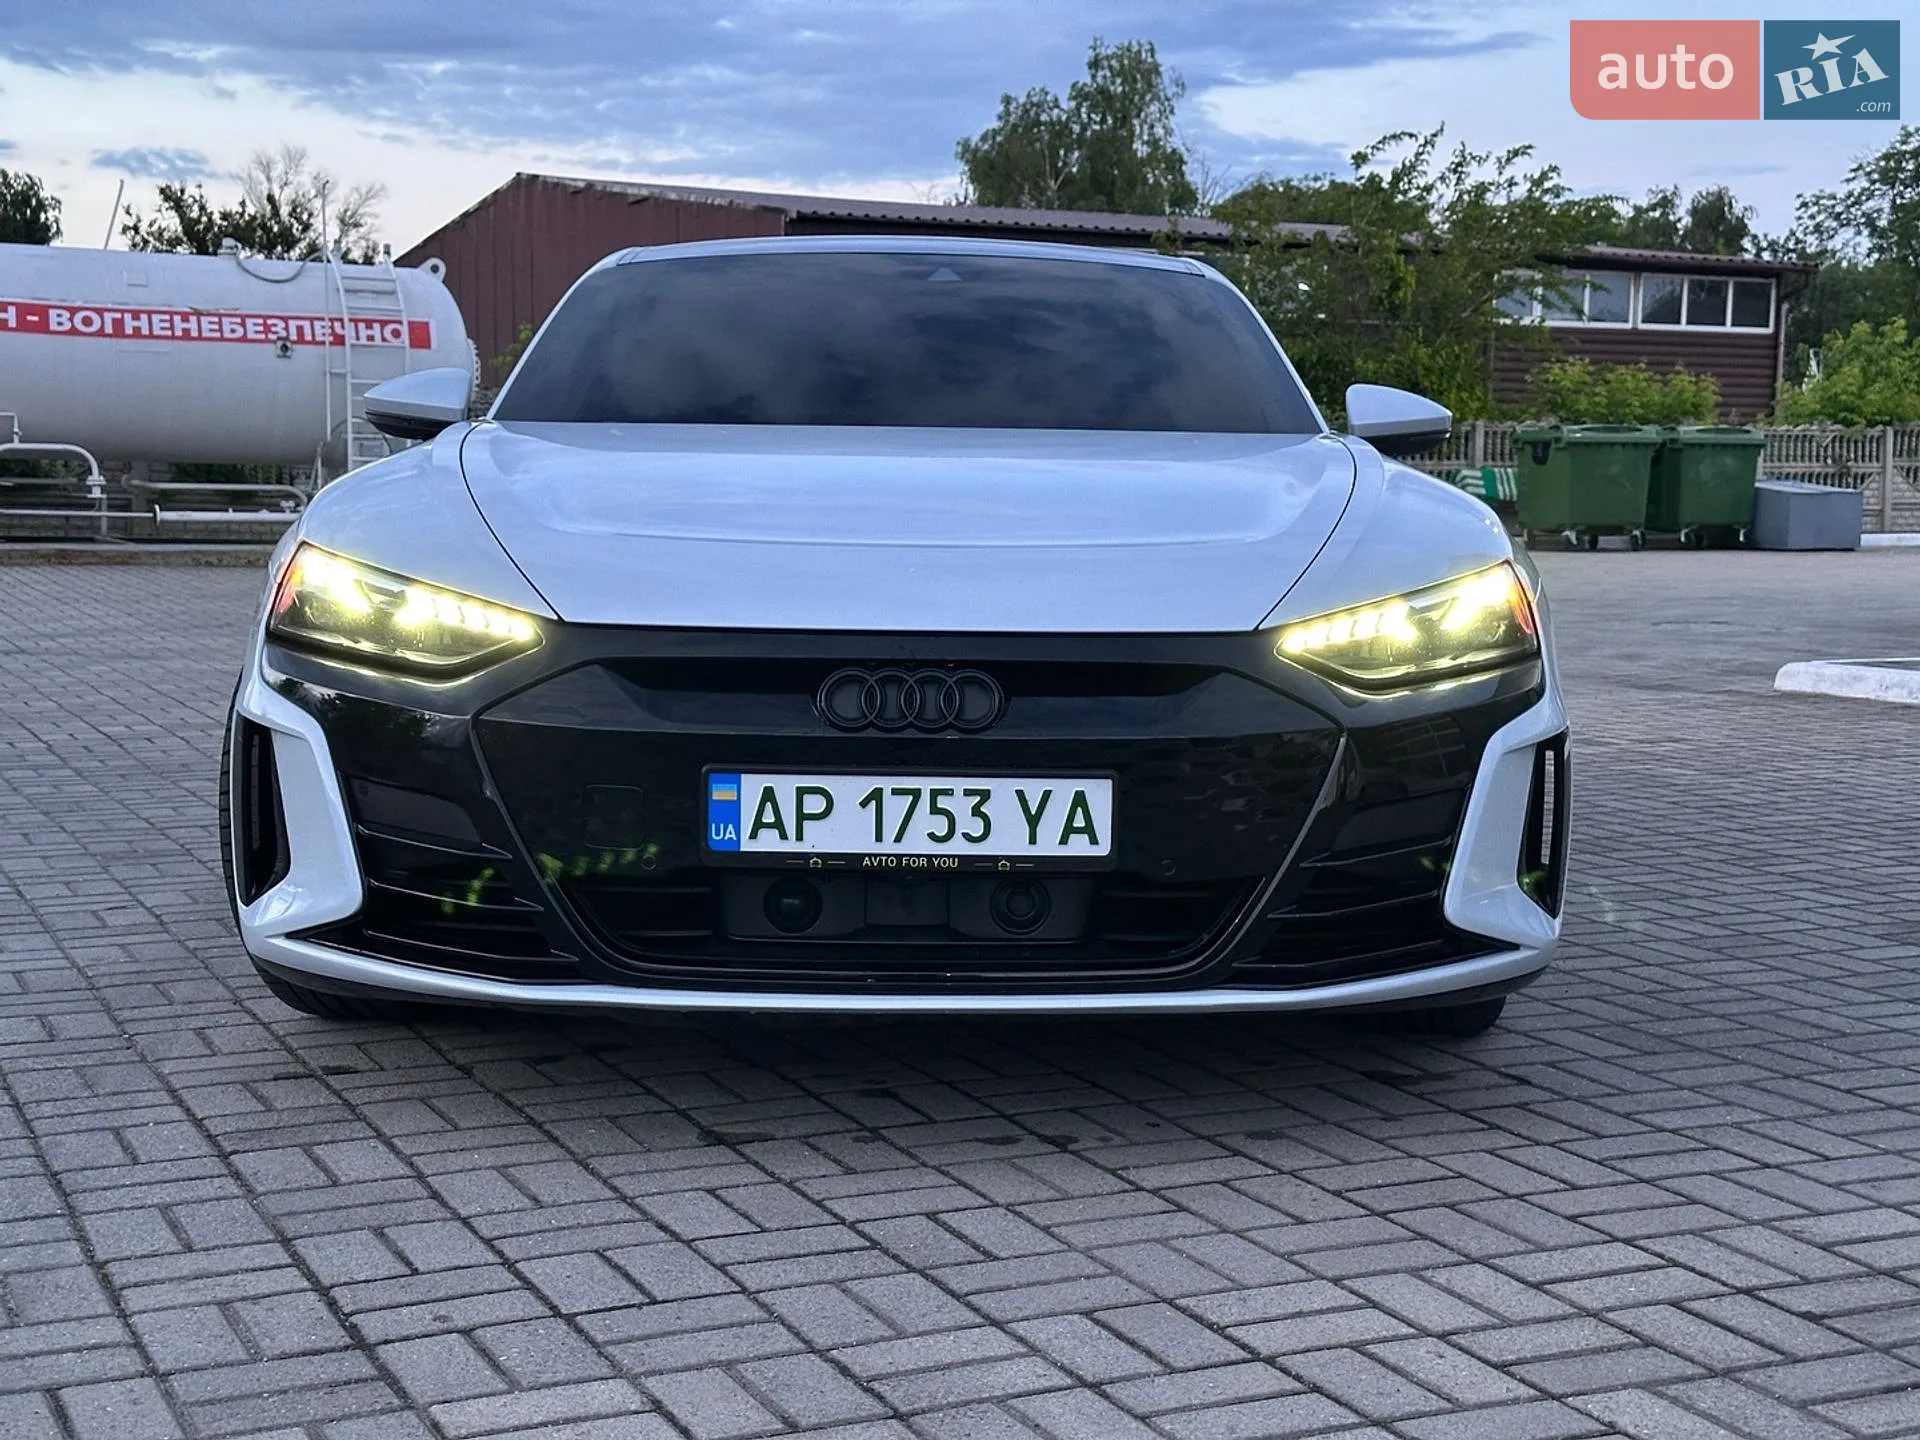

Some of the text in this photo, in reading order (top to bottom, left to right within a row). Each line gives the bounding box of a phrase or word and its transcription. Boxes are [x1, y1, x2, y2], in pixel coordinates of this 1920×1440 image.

[48, 307, 406, 345] ВОГНЕНЕБЕЗПЕЧНО
[747, 785, 1100, 846] AP 1753 YA
[711, 822, 737, 841] UA
[862, 856, 959, 868] AVTO FOR YOU
